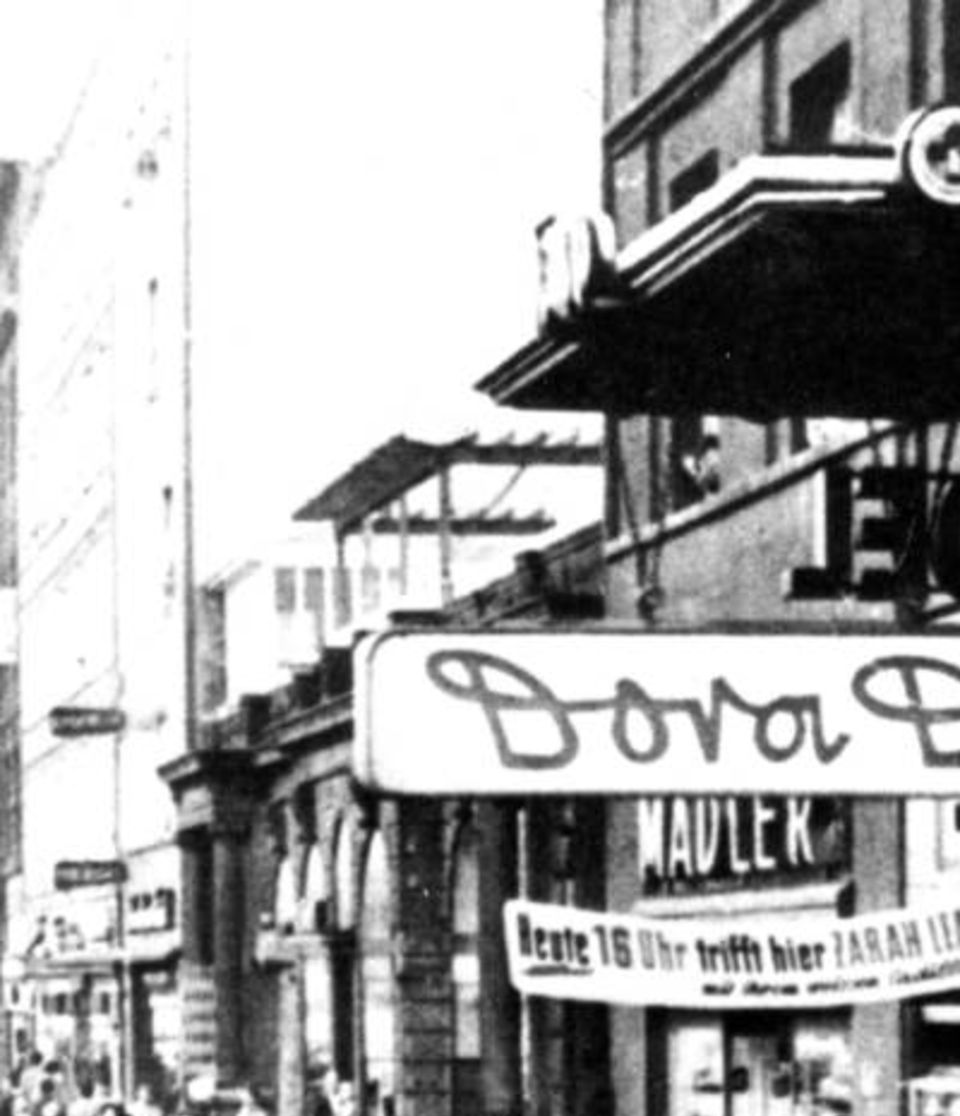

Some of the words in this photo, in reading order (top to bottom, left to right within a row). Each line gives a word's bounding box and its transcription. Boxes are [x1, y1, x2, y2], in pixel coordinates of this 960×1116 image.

[425, 649, 851, 771] Dora
[517, 913, 590, 967] Heute
[591, 923, 633, 969] 16
[637, 928, 687, 971] Uhr
[695, 932, 763, 974] trifft
[768, 934, 826, 973] hier
[831, 919, 924, 969] ZARAH
